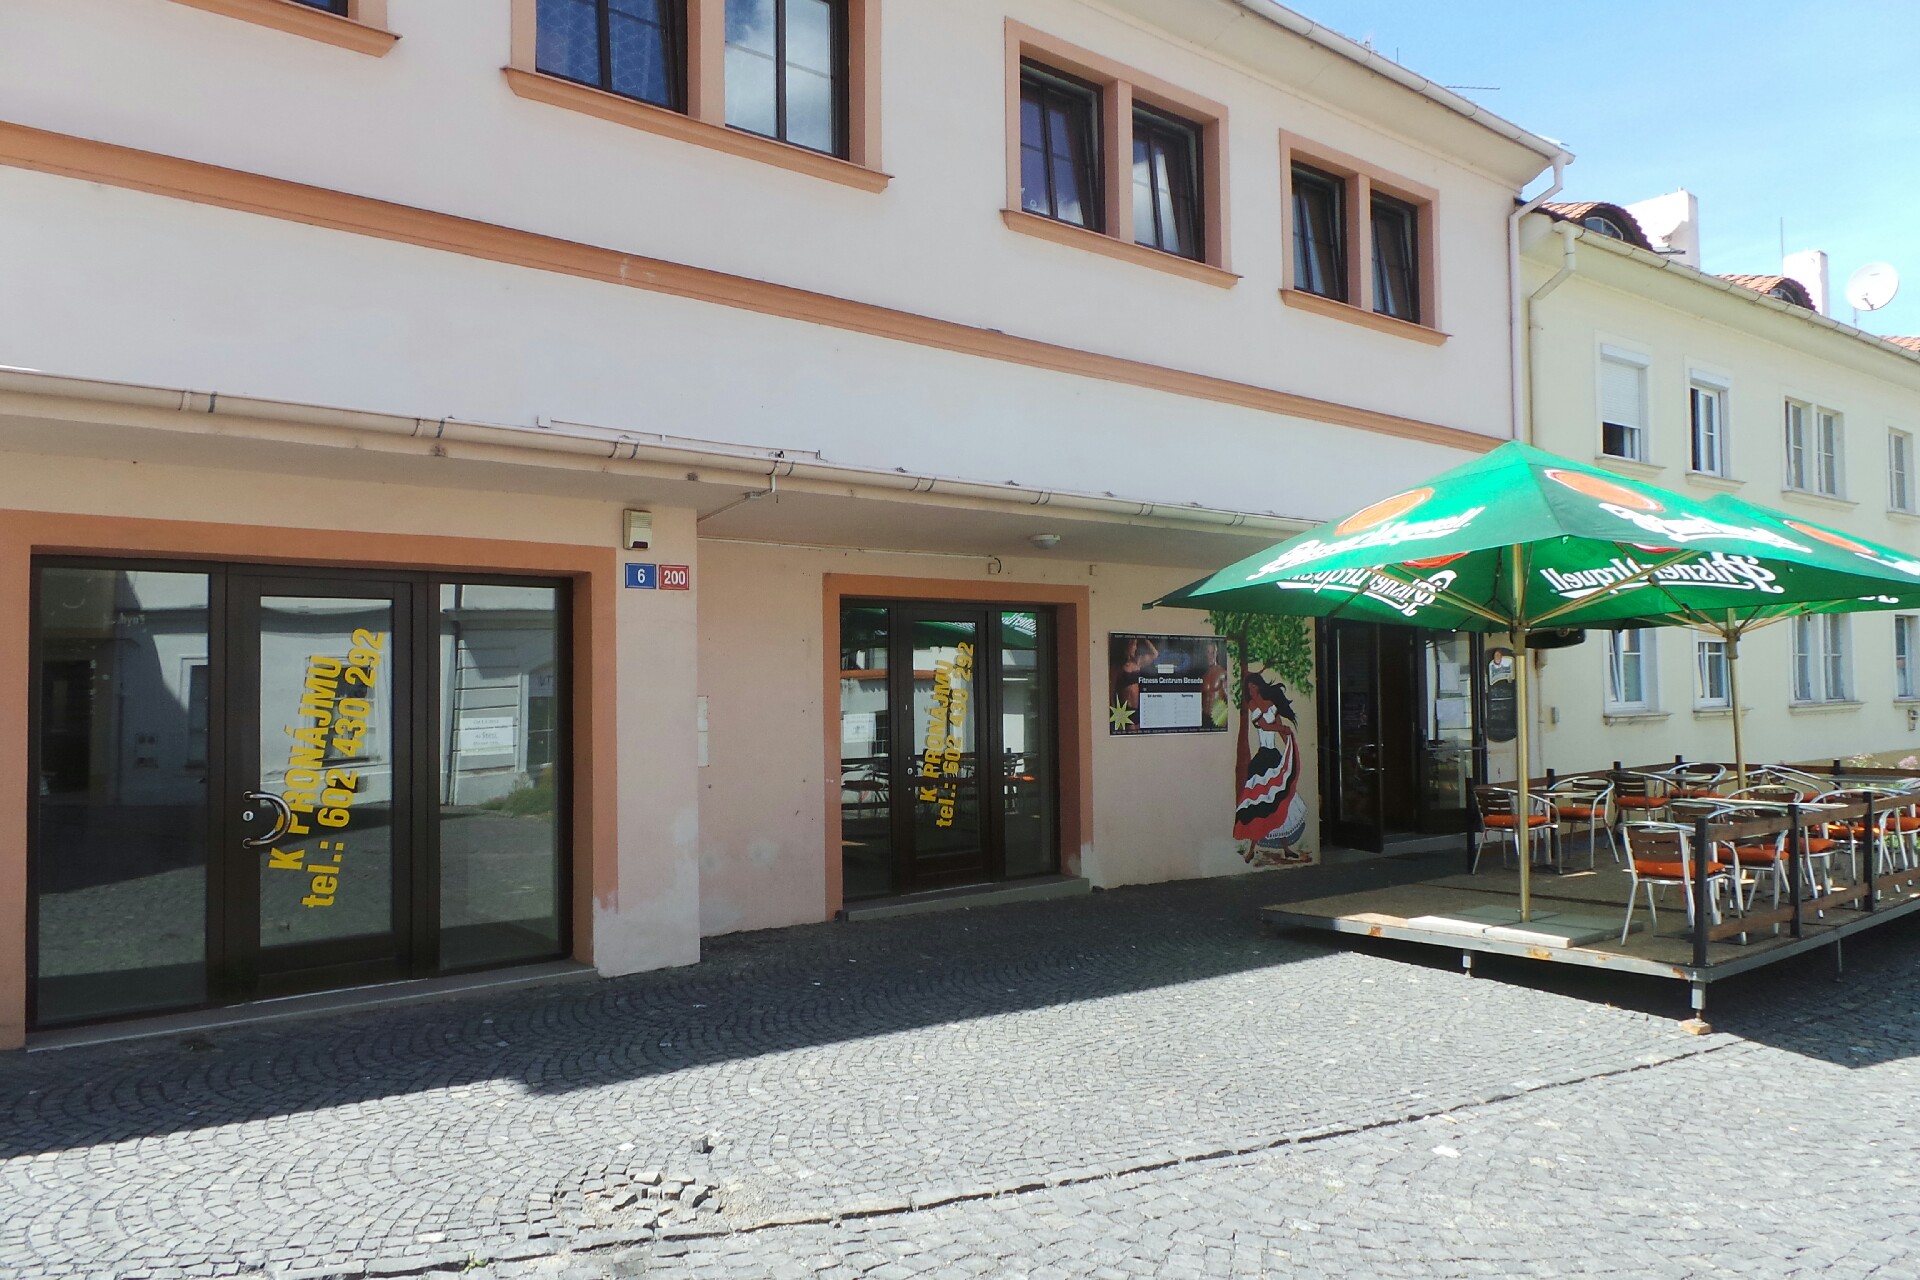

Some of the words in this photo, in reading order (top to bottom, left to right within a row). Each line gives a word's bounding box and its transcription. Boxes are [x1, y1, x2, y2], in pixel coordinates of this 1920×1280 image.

[637, 568, 646, 584] 6
[663, 570, 686, 585] 200
[344, 628, 385, 688] 292
[953, 641, 975, 682] 292
[332, 697, 371, 758] 430
[922, 659, 953, 779] PRONÁJMU
[949, 688, 969, 728] 430
[275, 655, 342, 835] PRONÁJMU
[942, 734, 962, 774] 602
[317, 768, 359, 828] 602
[919, 786, 938, 802] K
[936, 782, 957, 828] tel.:
[268, 847, 306, 871] K
[301, 840, 344, 909] tel.:
